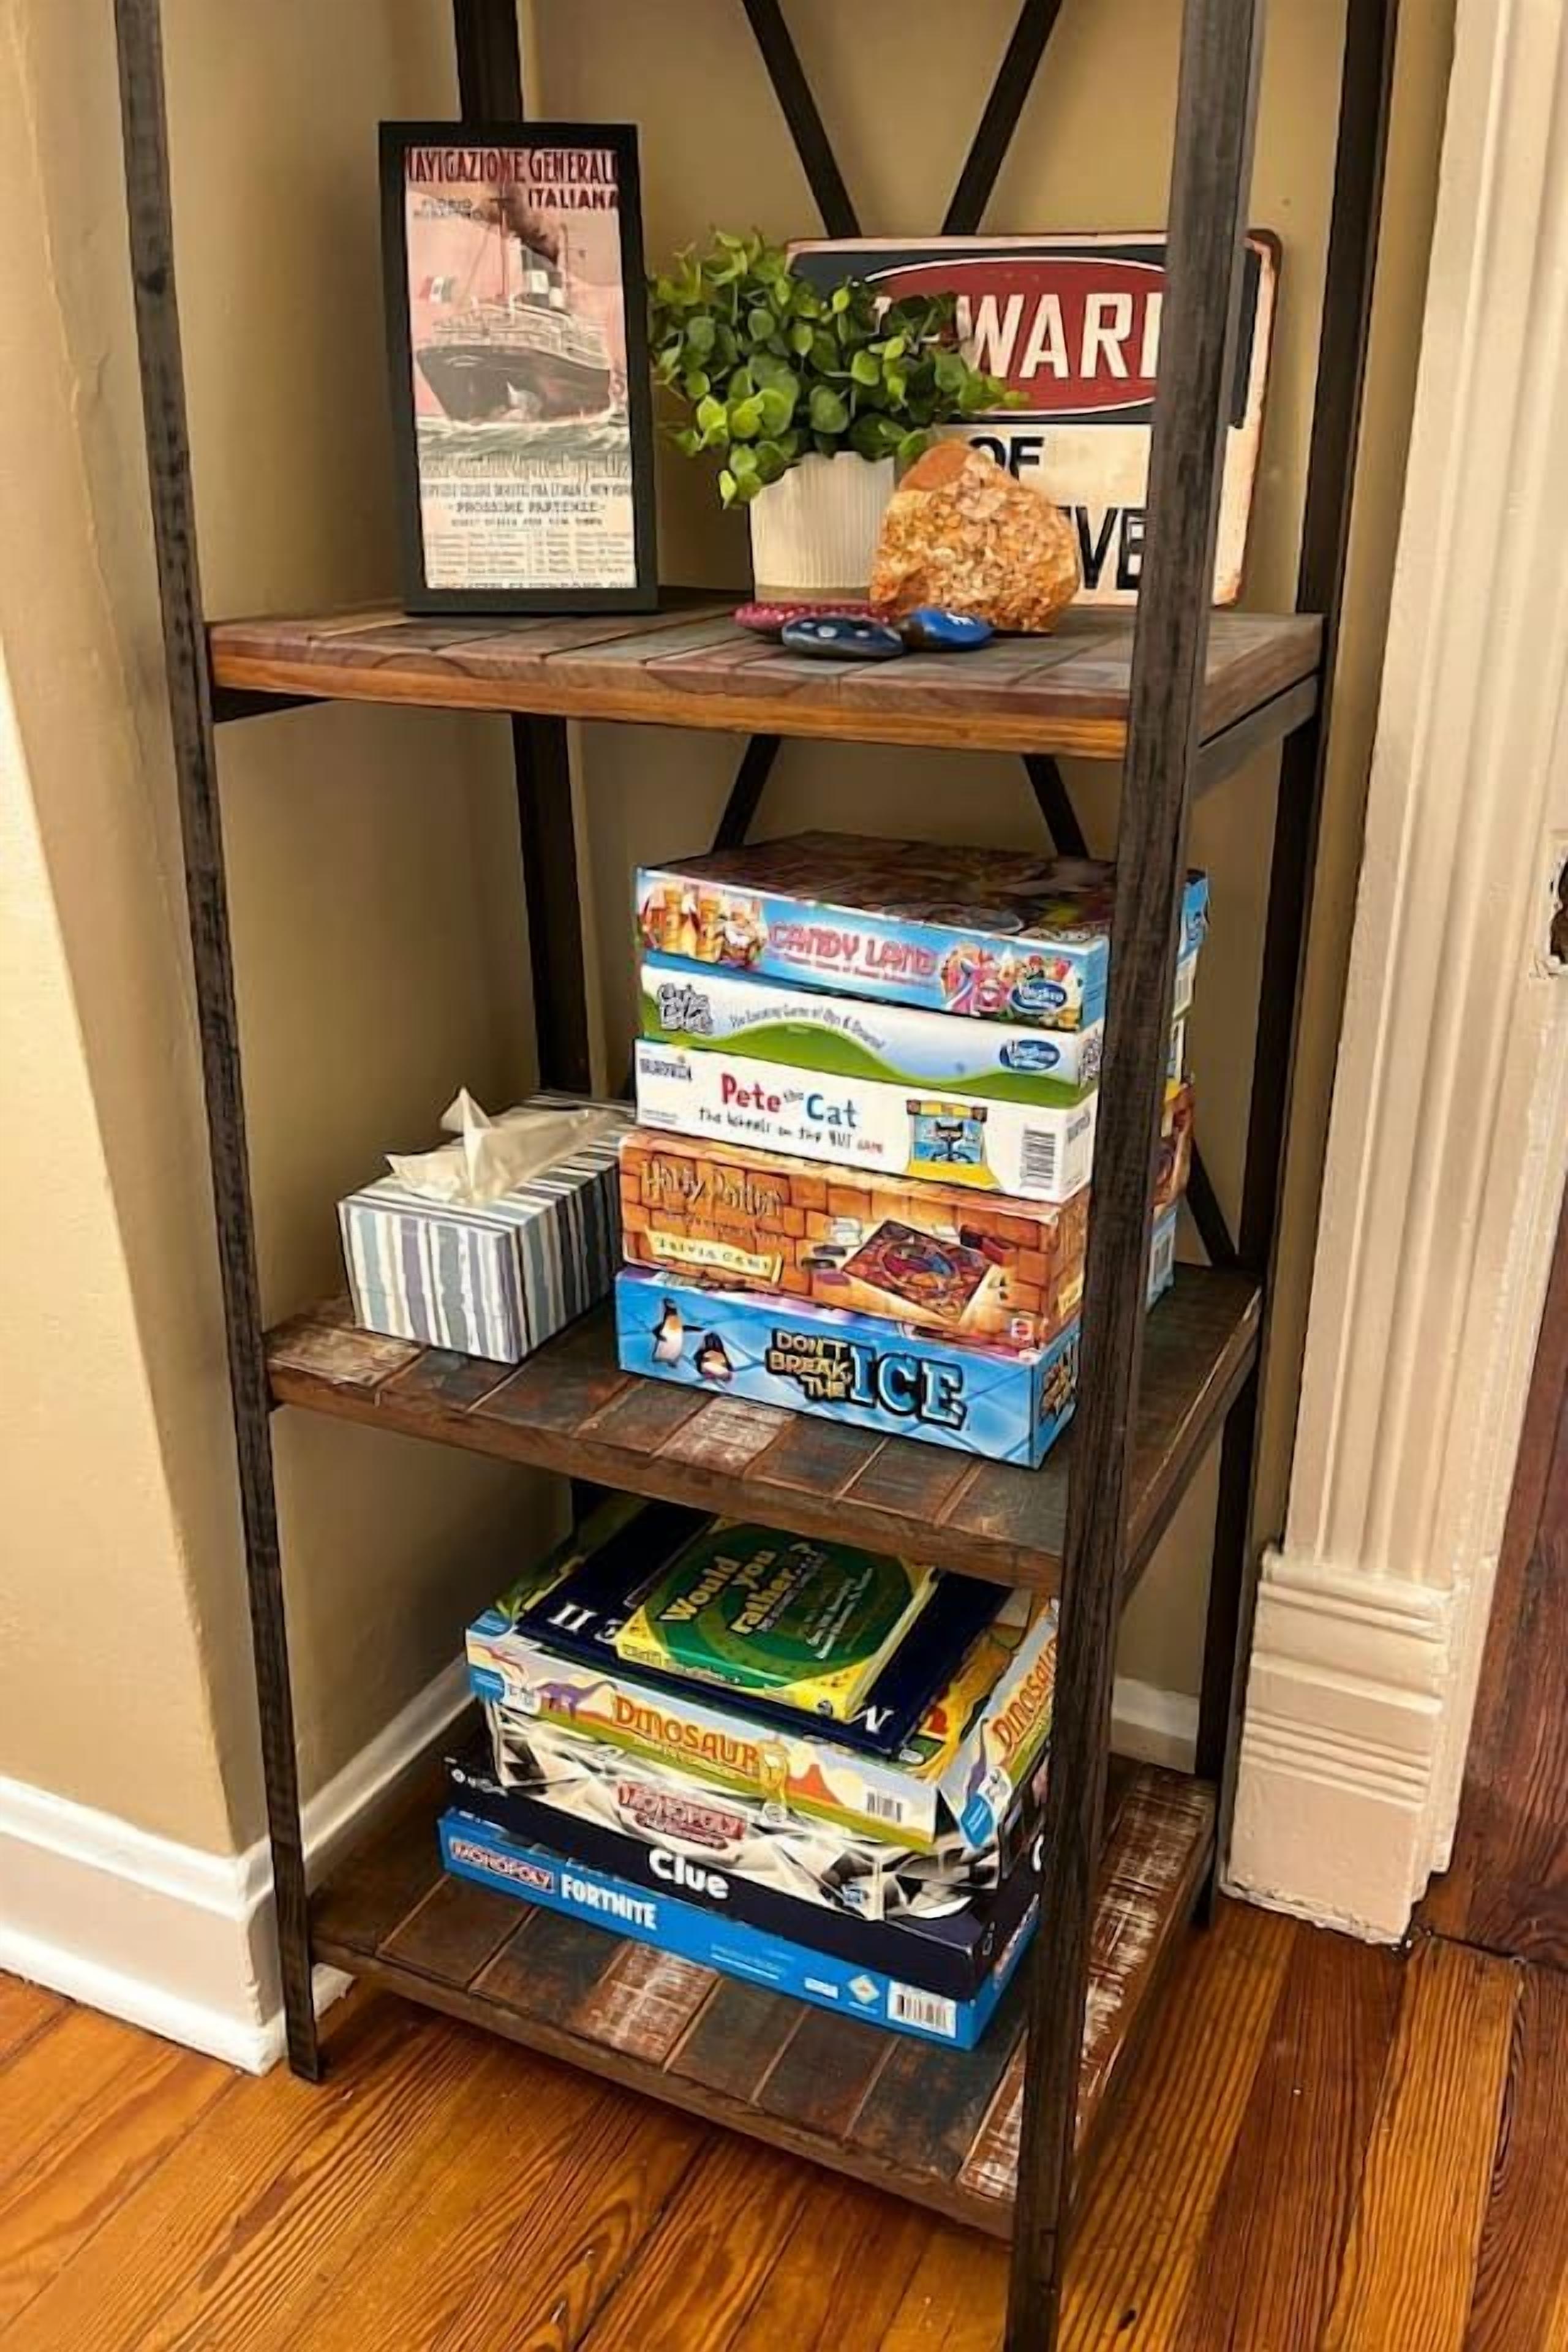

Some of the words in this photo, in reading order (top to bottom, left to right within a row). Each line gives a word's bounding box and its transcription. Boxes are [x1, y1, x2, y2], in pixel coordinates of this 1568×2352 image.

[769, 924, 860, 961] CANDY
[865, 938, 939, 976] LAND
[721, 1072, 781, 1113] Pete
[806, 1093, 858, 1128] Cat
[769, 1349, 854, 1385] BREAK
[800, 1374, 847, 1400] THE
[848, 1344, 968, 1430] ICE
[660, 1556, 741, 1621] Would
[731, 1550, 777, 1590] you
[649, 1849, 731, 1900] Clue
[560, 1873, 658, 1931] FORTNITE
